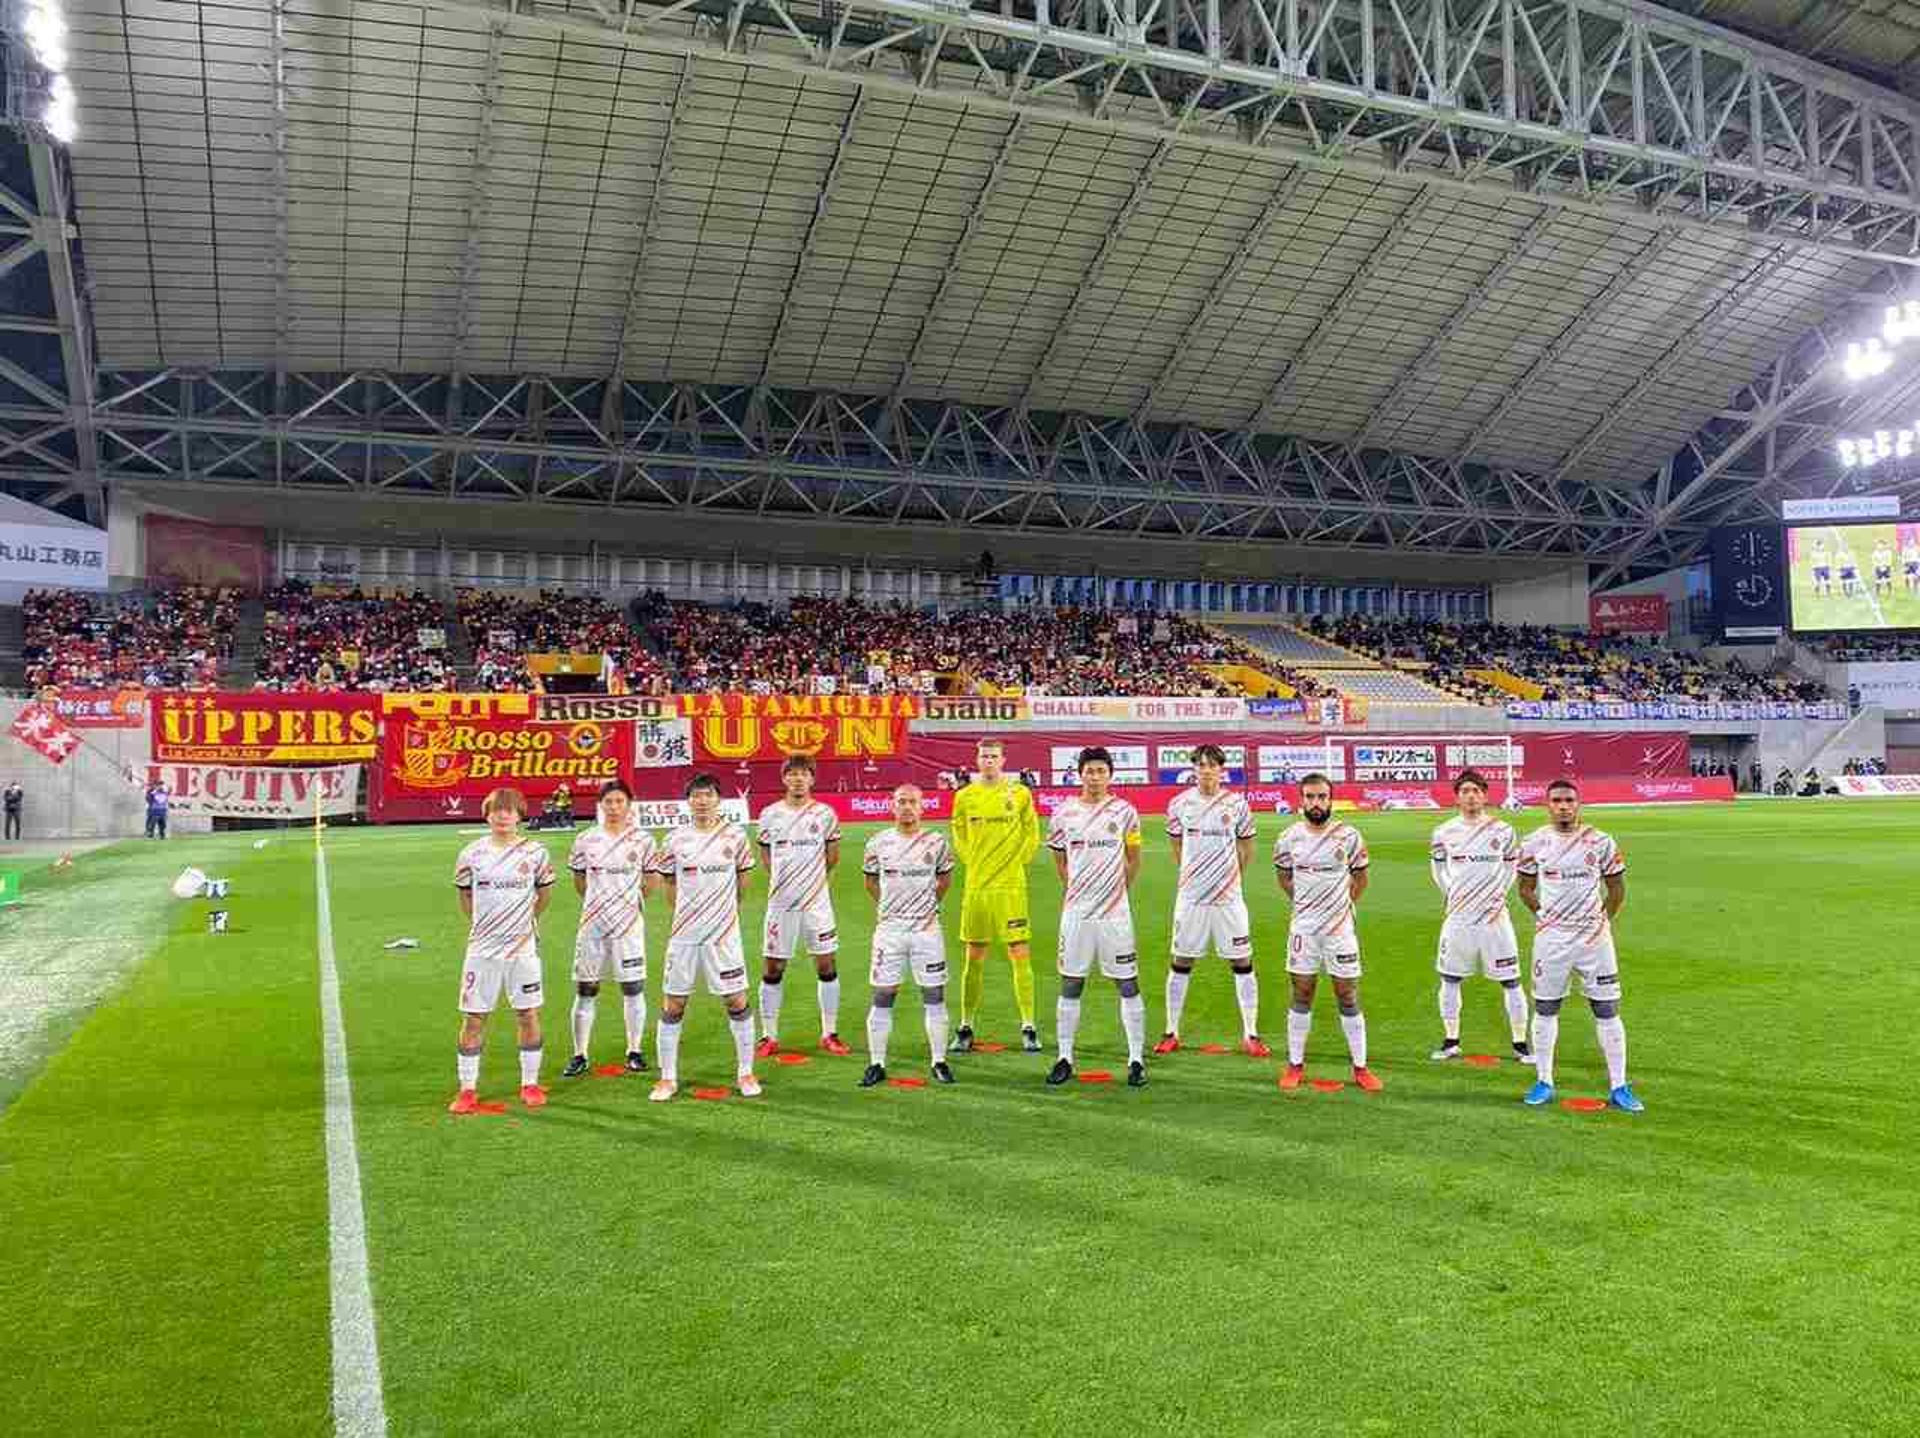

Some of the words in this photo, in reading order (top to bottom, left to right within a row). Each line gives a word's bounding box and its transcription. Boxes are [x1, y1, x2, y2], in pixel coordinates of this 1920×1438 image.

[539, 696, 662, 720] Rosso
[452, 725, 553, 751] Rosso
[467, 751, 619, 778] Brillante
